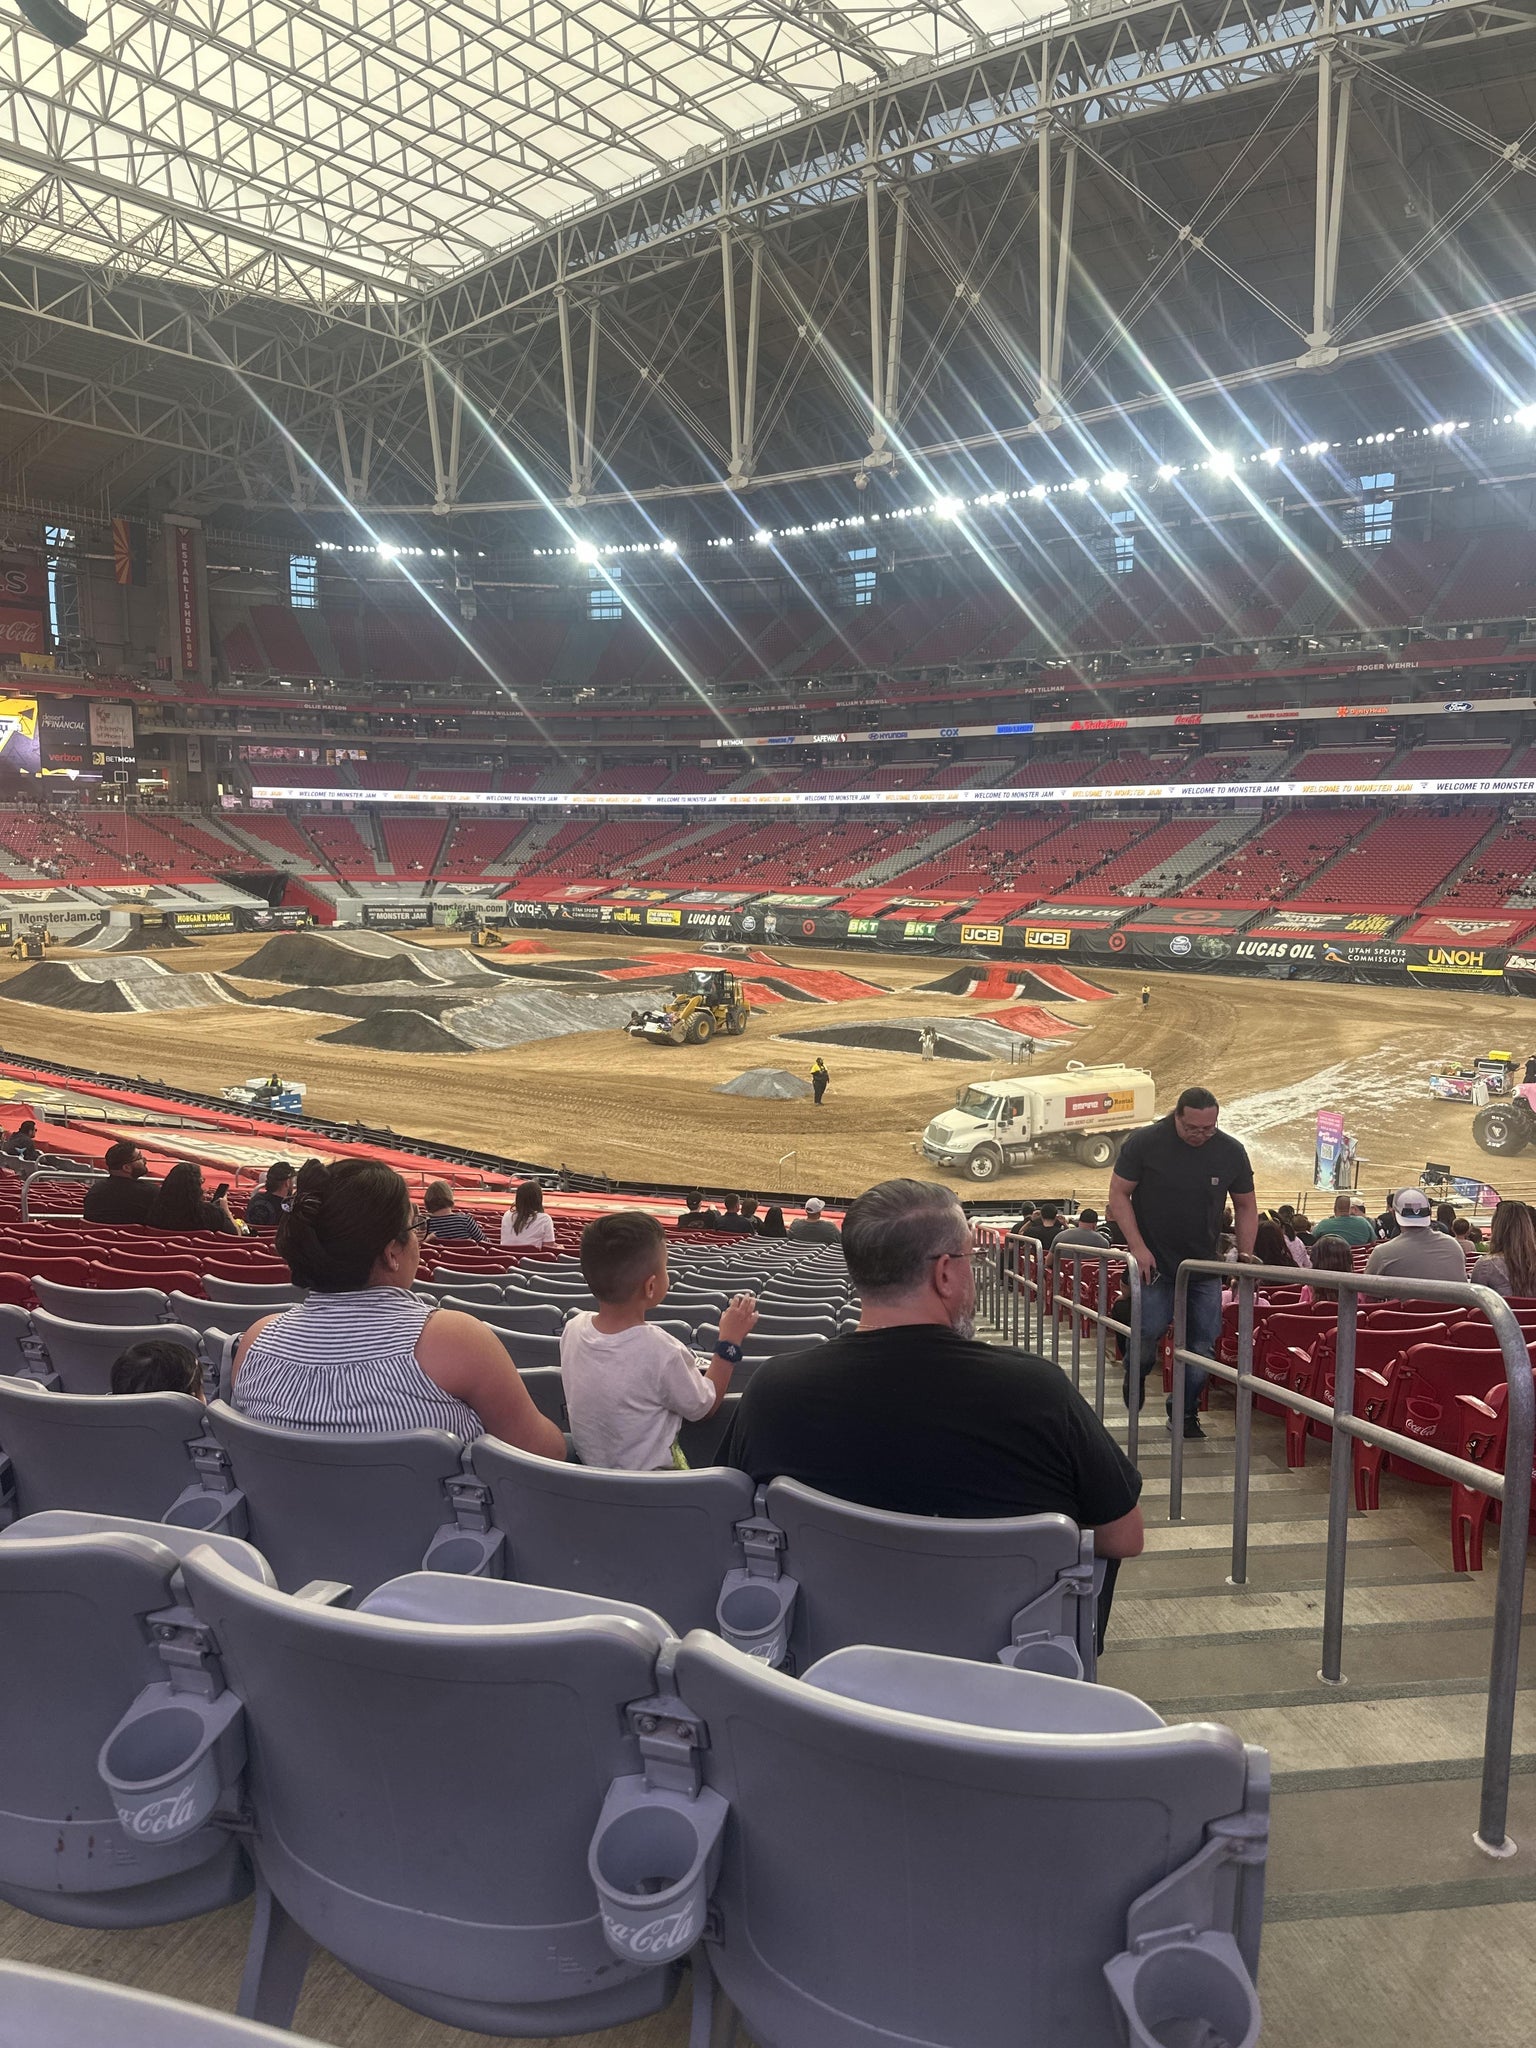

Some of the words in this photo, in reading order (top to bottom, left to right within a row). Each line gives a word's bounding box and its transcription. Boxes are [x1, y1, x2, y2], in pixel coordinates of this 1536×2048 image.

[181, 542, 192, 634] ESTABLISHED
[1357, 662, 1384, 671] ROGER
[1386, 661, 1419, 670] WEHRLI
[1037, 685, 1065, 693] TILLMAN
[1449, 702, 1468, 711] Ford
[940, 728, 959, 737] COX
[813, 734, 839, 743] SAFEWAY
[48, 753, 83, 762] verizon
[106, 755, 136, 763] BETMGM
[1181, 787, 1216, 795] WELCOME
[1217, 786, 1225, 794] TO
[1227, 786, 1262, 794] MONSTER
[1263, 785, 1280, 793] JAM
[1302, 785, 1340, 793] WELCOME
[1342, 784, 1351, 792] TO
[1353, 784, 1392, 792] MONSTER
[1394, 783, 1413, 791] JAM
[1436, 782, 1478, 791] WELCOME
[1480, 782, 1490, 790] TO
[1492, 781, 1535, 790] MONSTER
[19, 911, 102, 924] MonsterJam.co
[177, 914, 201, 923] MORGAN
[207, 913, 231, 922] MORGAN
[376, 912, 410, 920] MONSTER
[411, 912, 427, 920] JAM
[687, 913, 716, 925] LUCAS
[717, 914, 731, 926] OIL
[848, 919, 879, 933] BKT
[904, 922, 936, 936] BKT
[964, 928, 1000, 942] JCB
[1028, 931, 1067, 946] JCB
[1236, 941, 1289, 957] LUCAS
[1289, 944, 1316, 960] OIL
[1374, 948, 1407, 957] SPORTS
[1347, 955, 1407, 963] COMMISSION
[1427, 947, 1484, 966] UNOH
